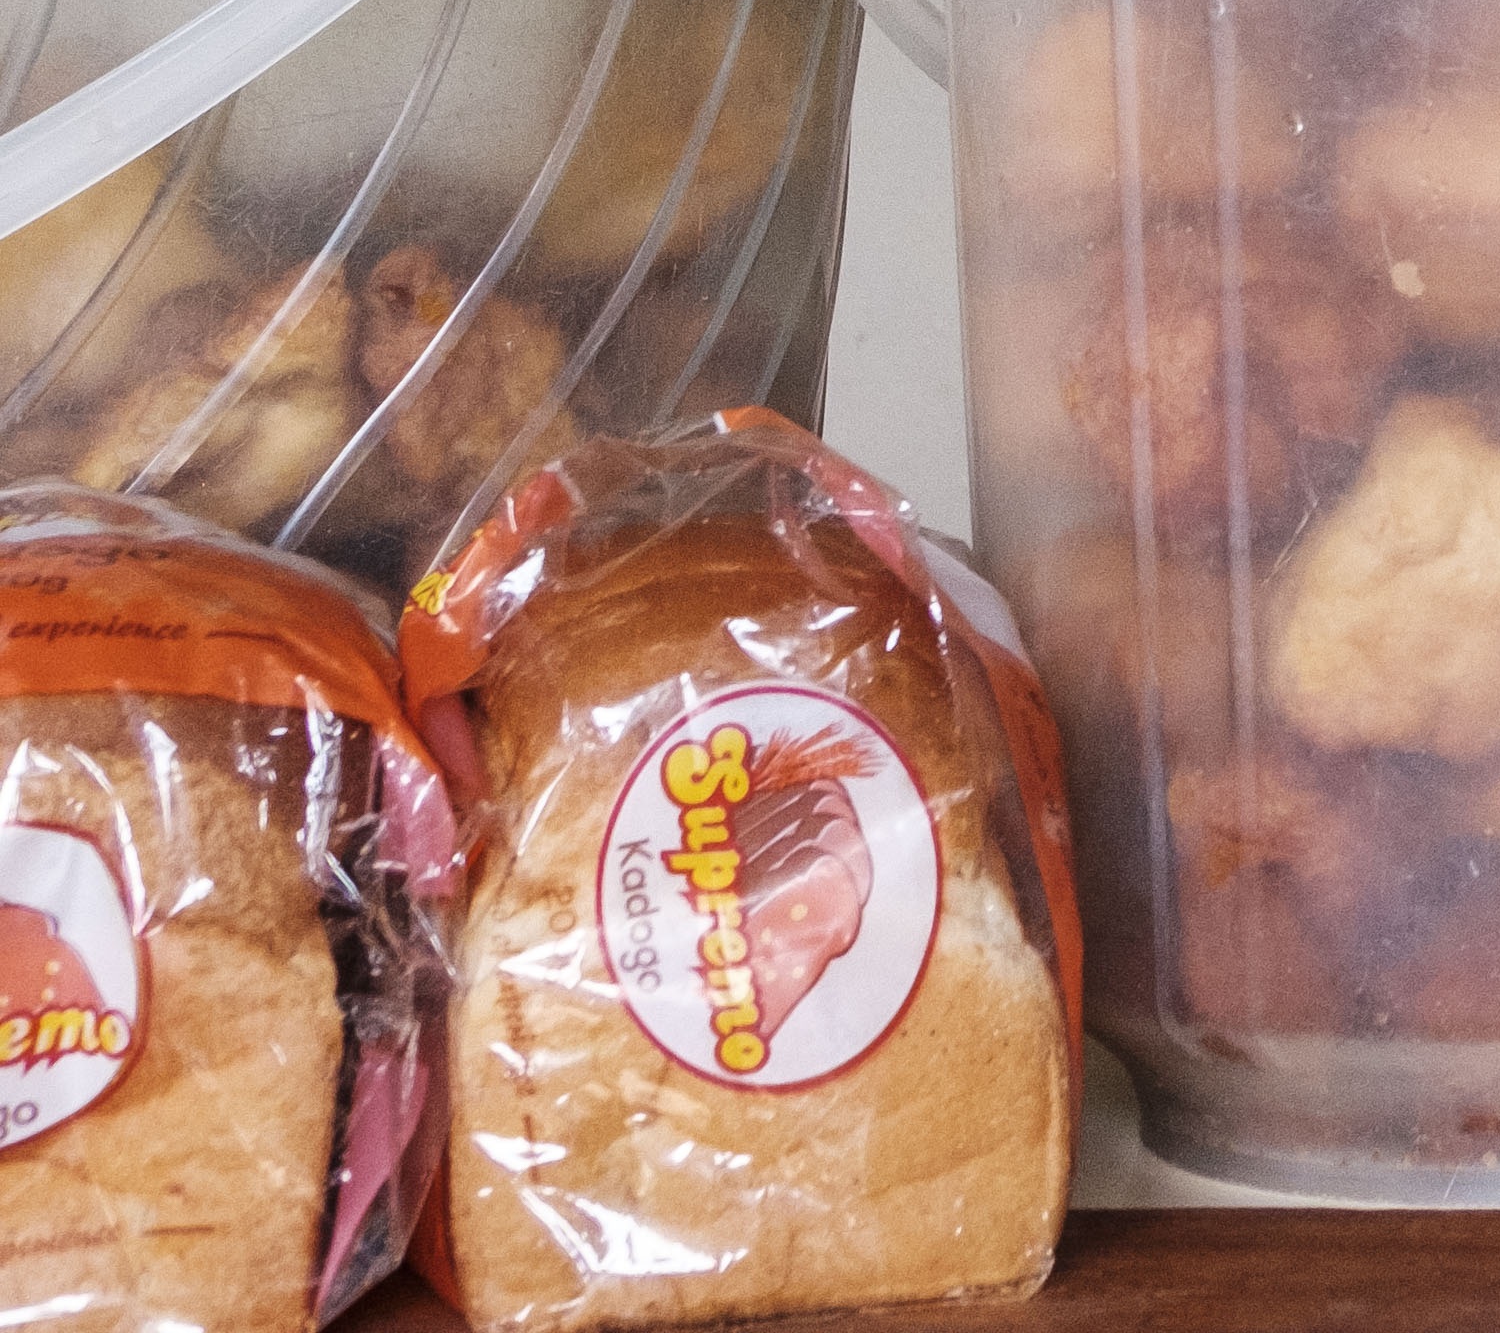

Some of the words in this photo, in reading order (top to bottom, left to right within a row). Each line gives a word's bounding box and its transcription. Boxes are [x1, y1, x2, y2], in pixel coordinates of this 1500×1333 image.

[8, 616, 190, 640] experience
[618, 836, 664, 994] Kadogo
[661, 721, 771, 1074] Supremo
